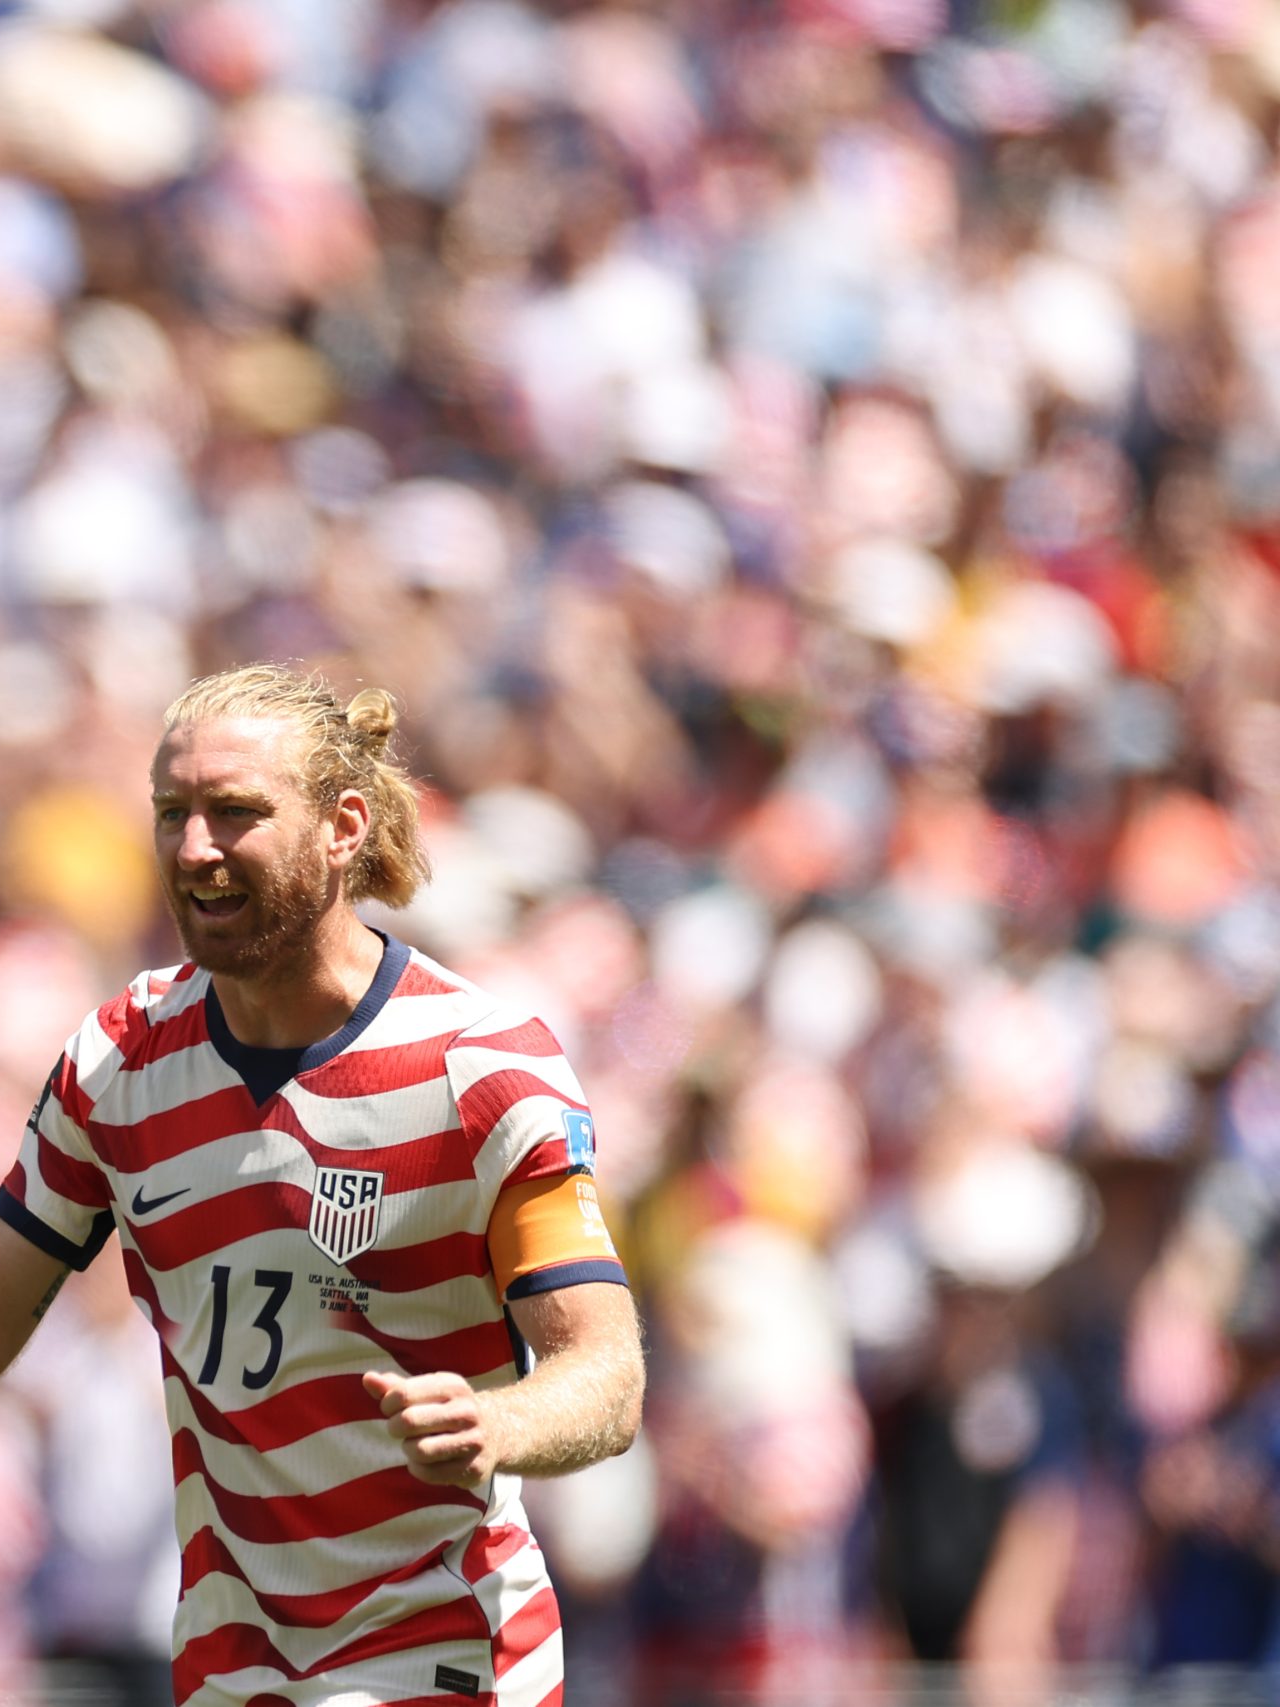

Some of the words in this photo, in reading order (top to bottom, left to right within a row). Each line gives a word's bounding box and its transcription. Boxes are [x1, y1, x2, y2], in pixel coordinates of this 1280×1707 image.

[319, 1172, 378, 1210] USA
[308, 1273, 322, 1284] USA
[356, 1291, 369, 1301] WA
[328, 1301, 348, 1312] JUNE
[197, 1264, 294, 1390] 13
